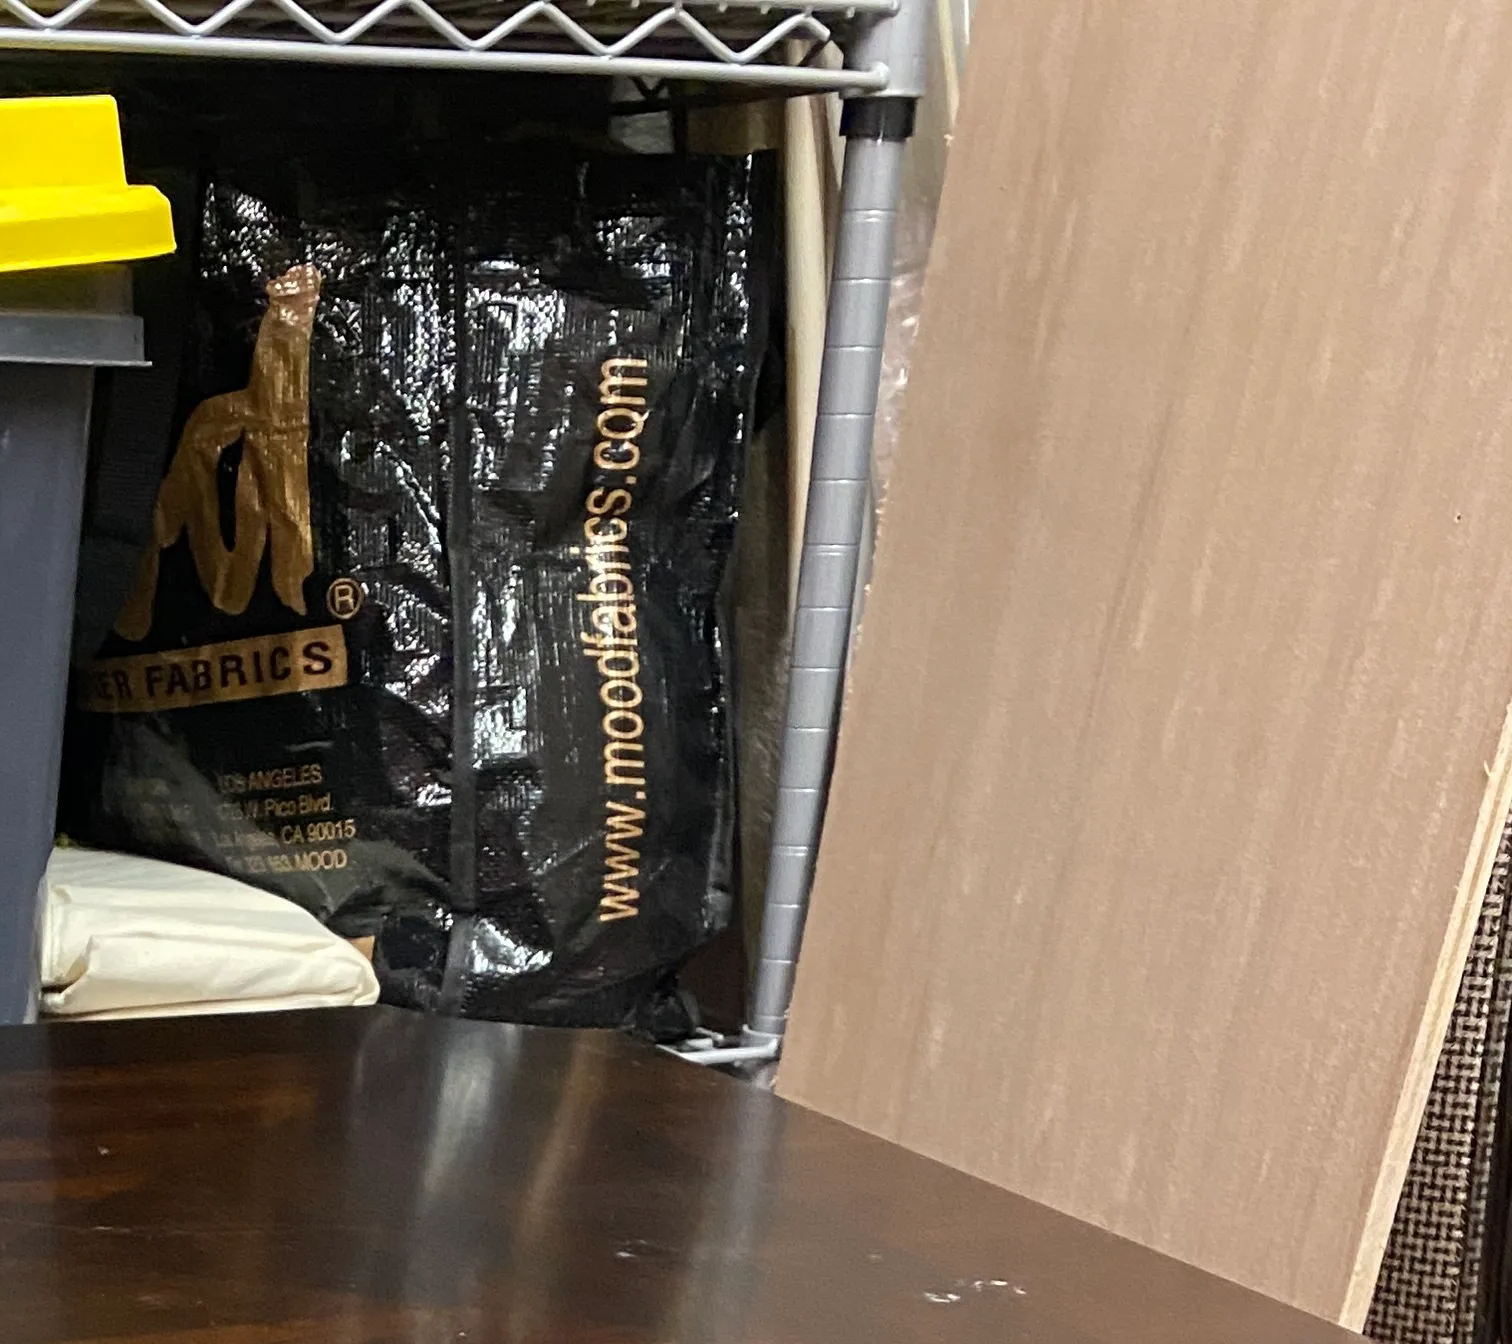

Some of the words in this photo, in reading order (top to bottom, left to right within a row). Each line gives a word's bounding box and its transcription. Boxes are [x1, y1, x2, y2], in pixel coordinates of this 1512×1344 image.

[571, 357, 648, 923] www.moodfabrics.com
[144, 640, 334, 699] FABRICS
[247, 763, 323, 792] ANGELES
[280, 824, 305, 845] CA
[306, 818, 357, 842] 90015
